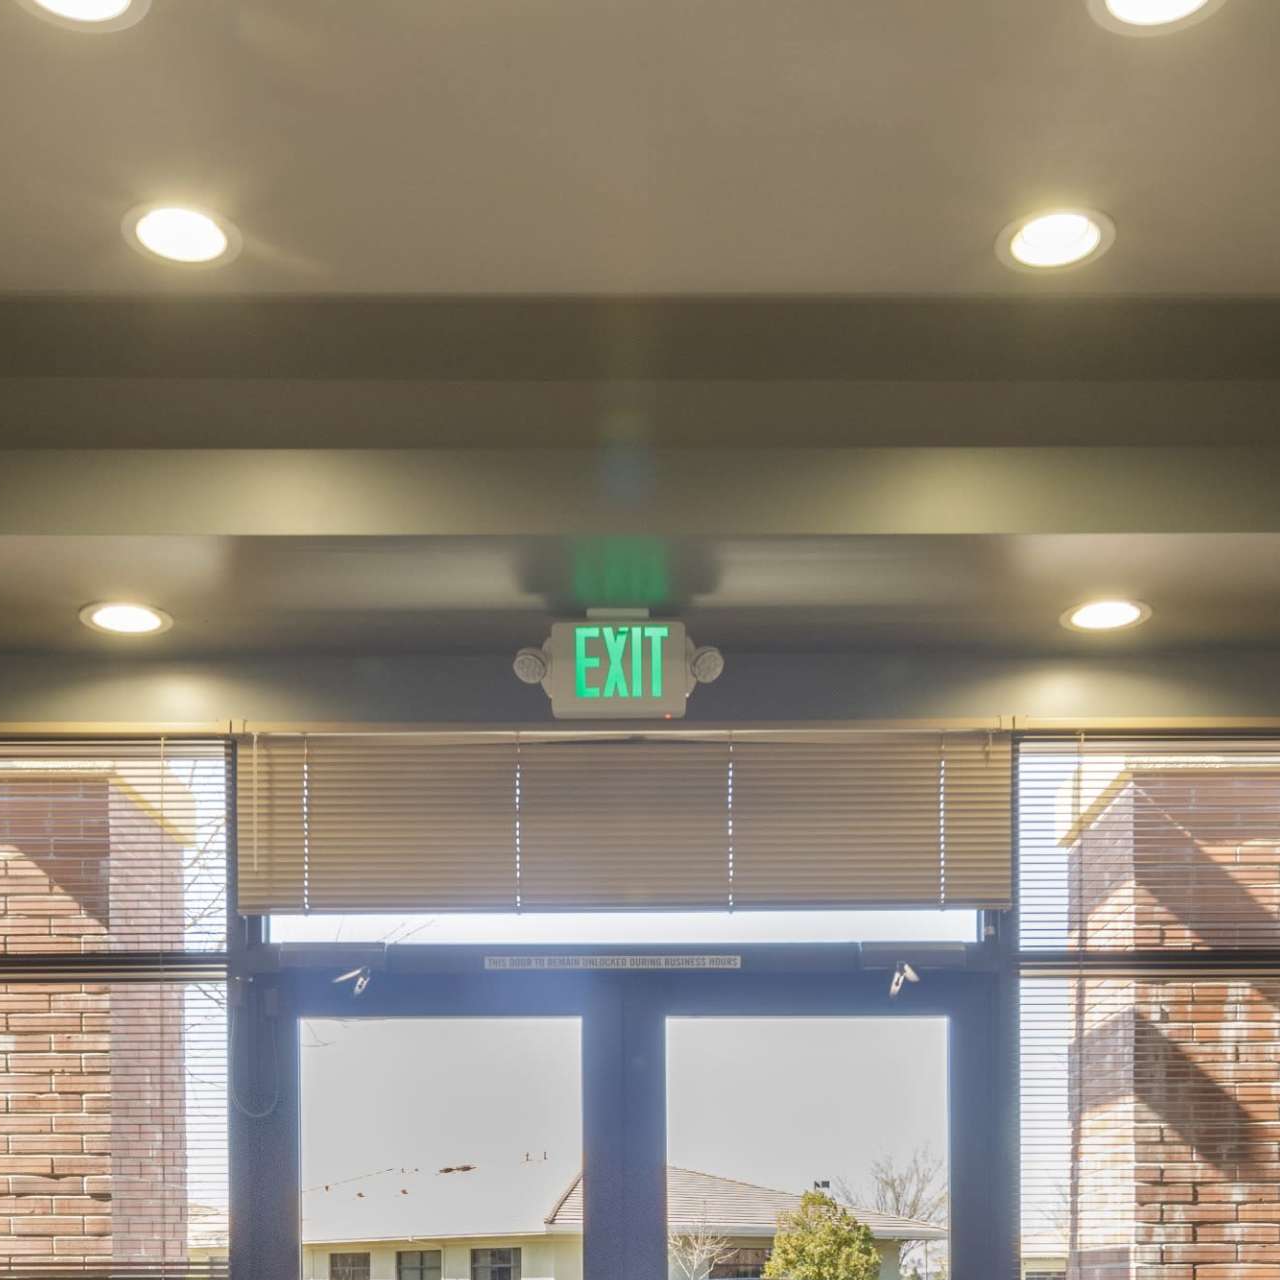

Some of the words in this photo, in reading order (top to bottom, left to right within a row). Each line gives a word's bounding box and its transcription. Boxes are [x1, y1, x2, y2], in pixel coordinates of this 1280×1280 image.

[575, 627, 669, 698] EXIT
[534, 958, 545, 968] TO
[547, 958, 580, 968] REMAIN
[582, 958, 627, 968] UNLOCKED
[629, 958, 662, 968] DURING
[664, 958, 706, 968] BUSINESS
[708, 958, 738, 968] HOURS
